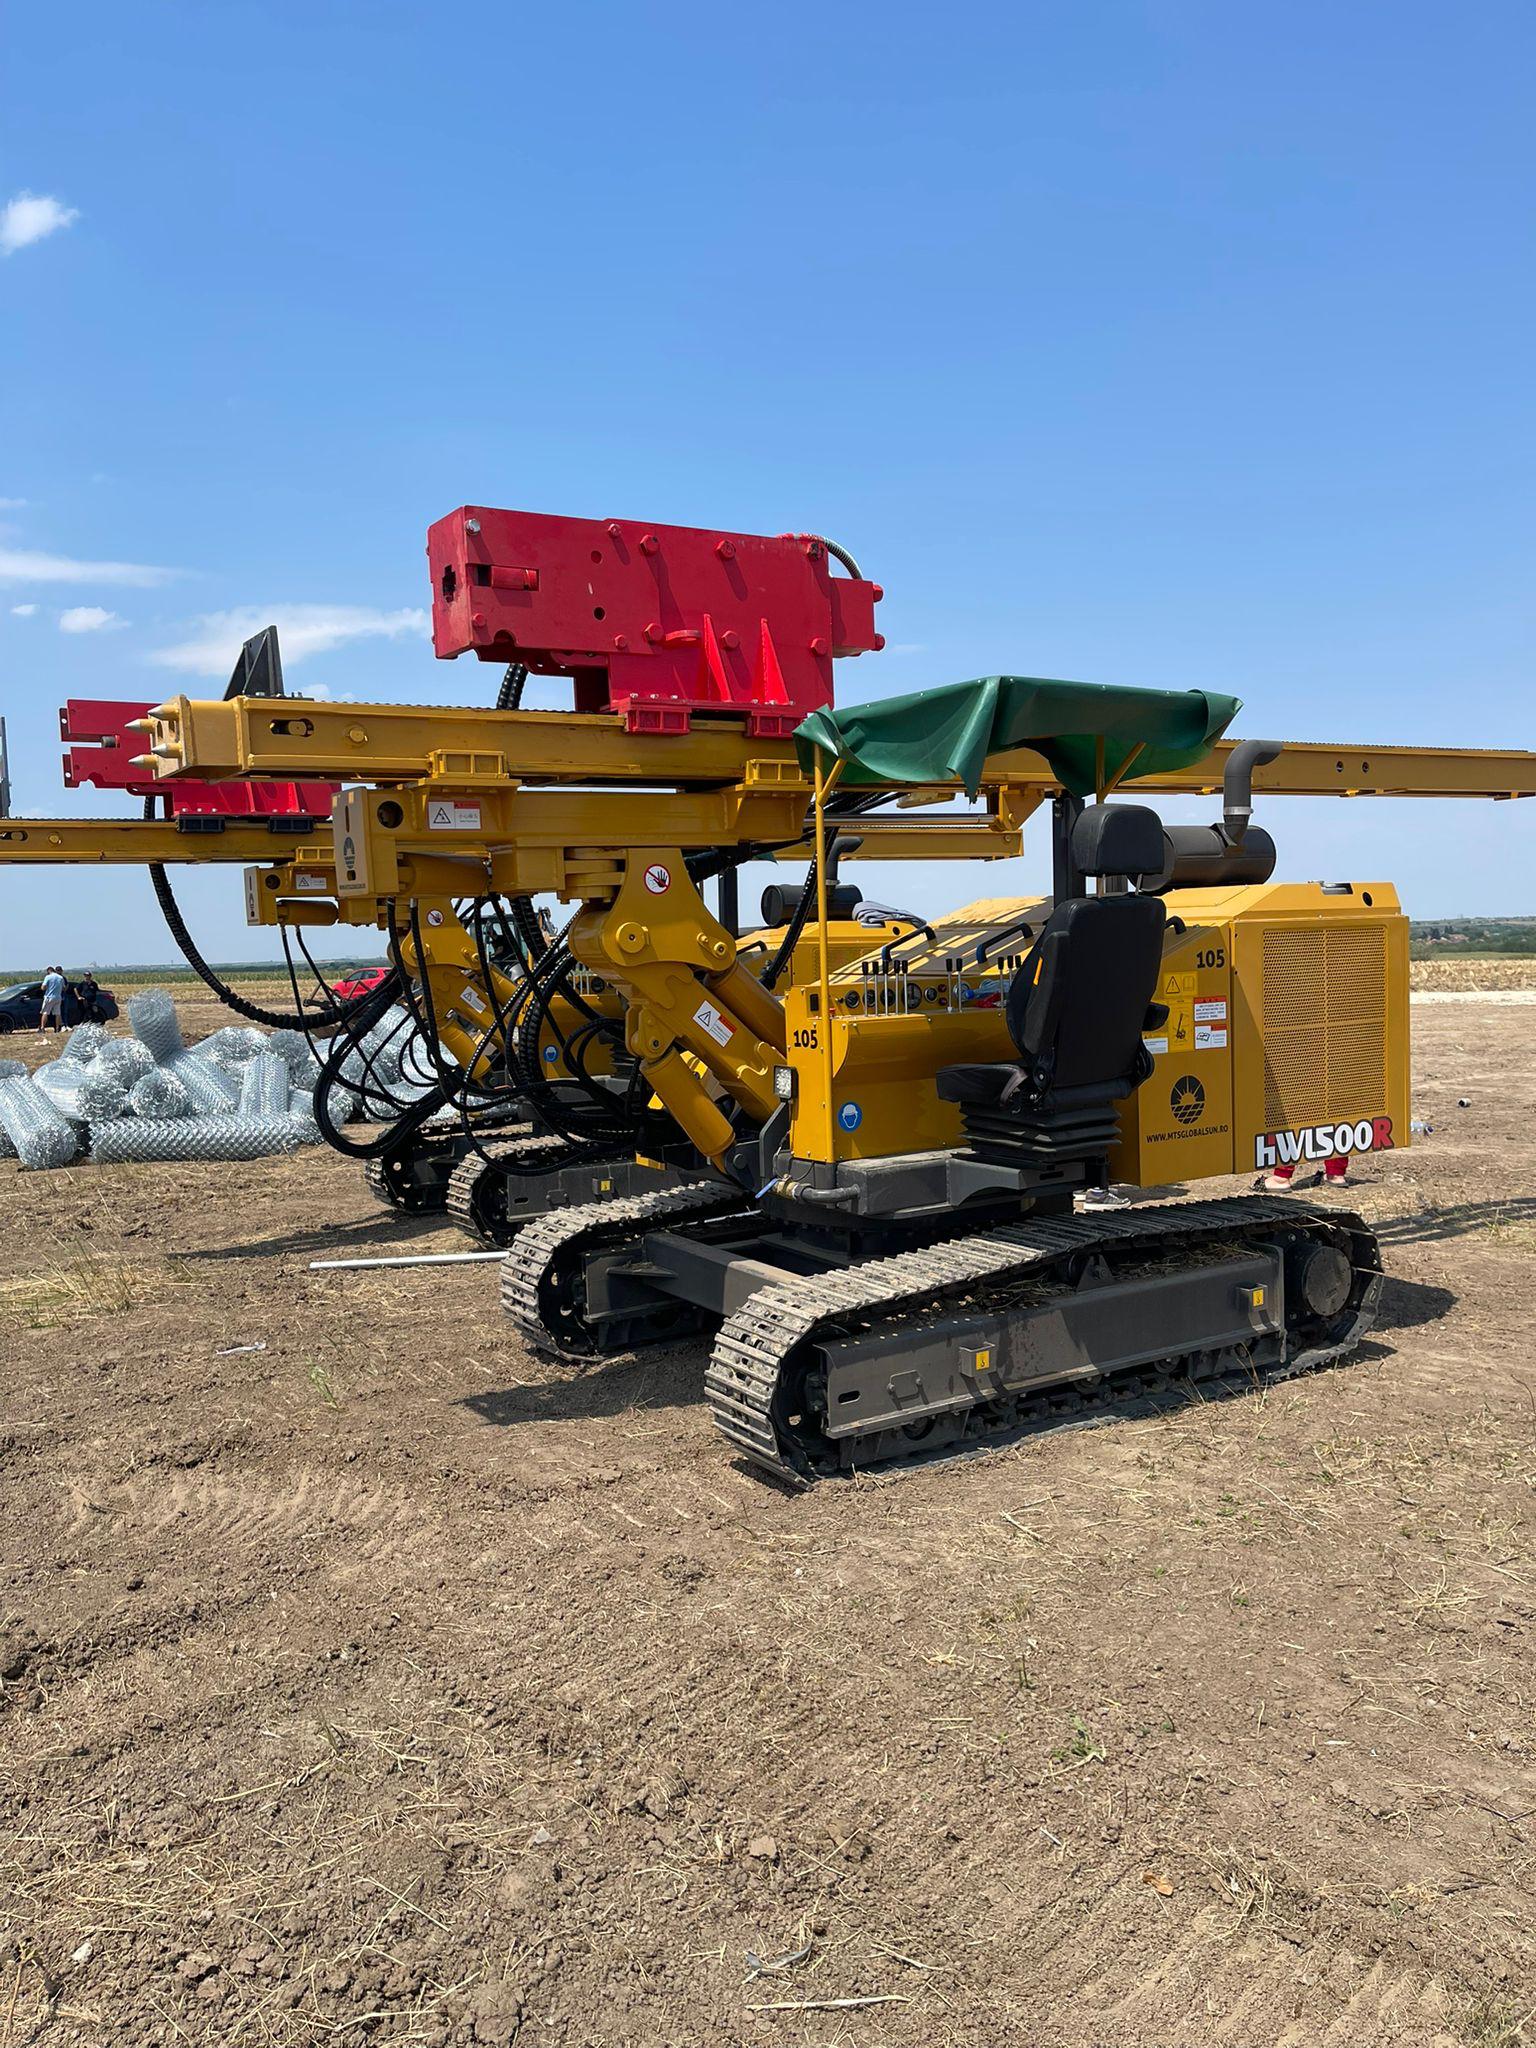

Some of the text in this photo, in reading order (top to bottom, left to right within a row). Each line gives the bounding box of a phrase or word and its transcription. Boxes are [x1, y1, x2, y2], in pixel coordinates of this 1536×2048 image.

[1196, 949, 1225, 968] 105
[793, 1030, 818, 1049] 105
[1145, 1125, 1229, 1143] WWW.MTSGLOBALSUN.RO
[1254, 1117, 1394, 1169] HWL500R
